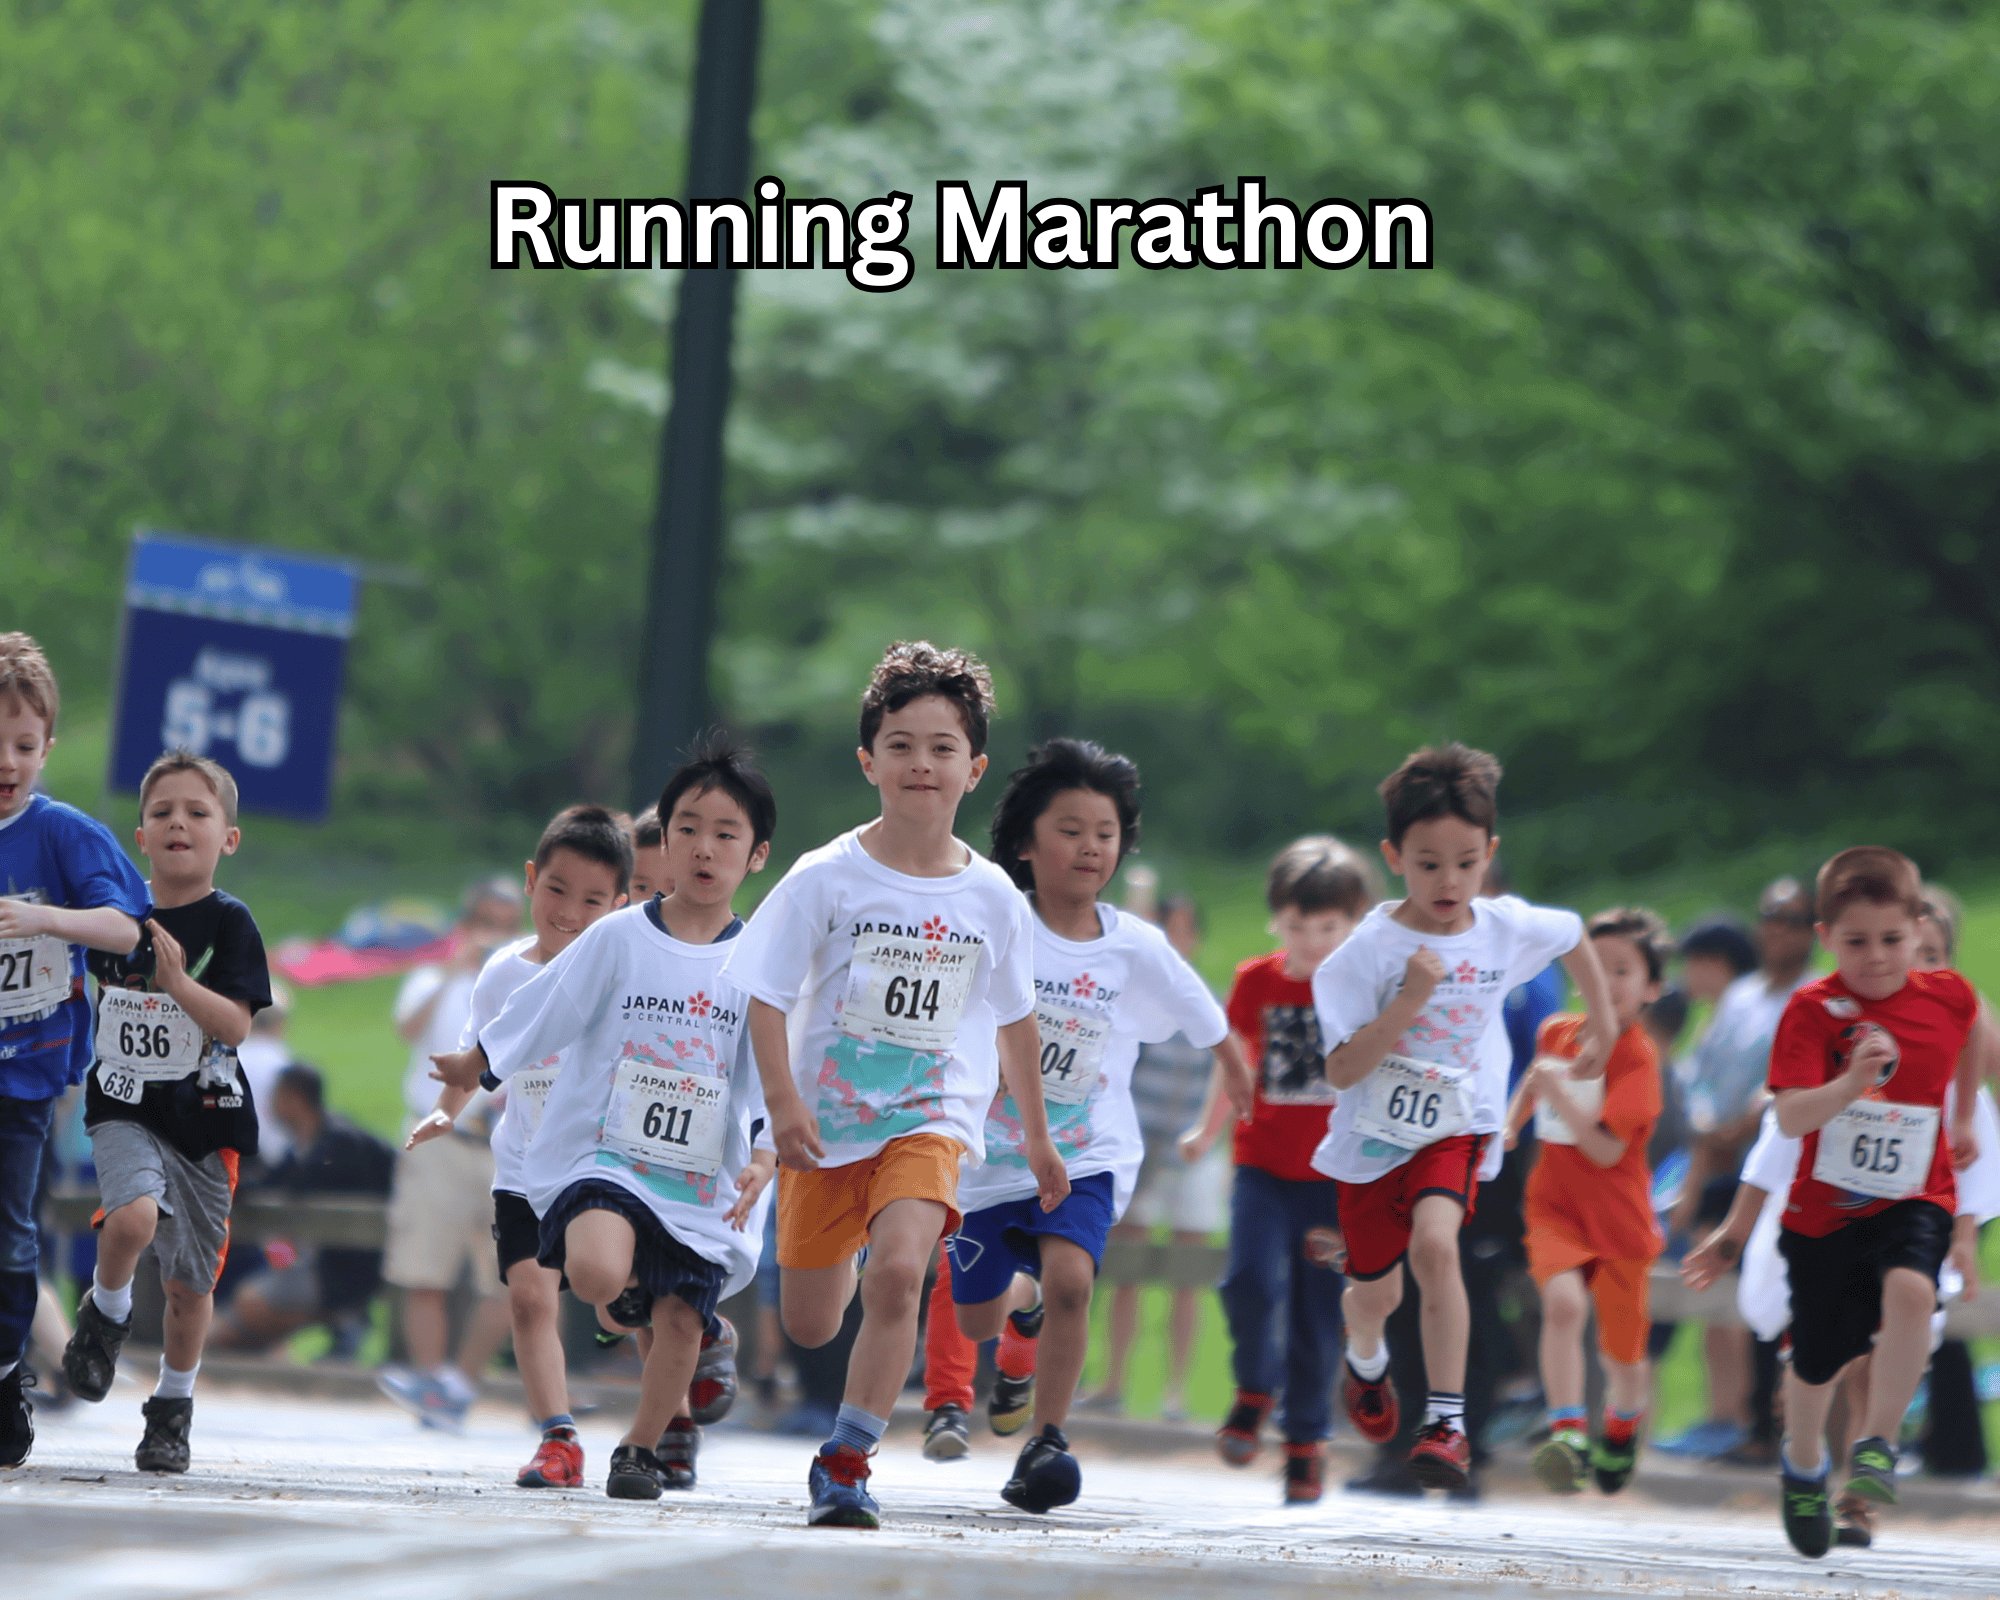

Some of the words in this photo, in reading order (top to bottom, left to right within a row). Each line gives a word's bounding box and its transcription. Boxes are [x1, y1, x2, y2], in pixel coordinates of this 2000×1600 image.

[162, 679, 291, 770] 5-6
[872, 946, 923, 963] JAPAN
[940, 954, 967, 965] DAY
[883, 961, 931, 973] CENTRAL
[107, 997, 142, 1012] JAPAN
[161, 1003, 185, 1013] DA
[622, 996, 685, 1014] JAPAN
[711, 1006, 739, 1026] DAY
[885, 975, 940, 1022] 614
[623, 1013, 630, 1021] @
[638, 1013, 700, 1029] CENTRAL
[1032, 1010, 1064, 1030] PAN
[1079, 1028, 1102, 1040] DAY
[120, 1022, 170, 1059] 636
[1039, 1037, 1078, 1081] 04
[103, 1071, 135, 1100] 636
[631, 1074, 678, 1092] JAPAN
[696, 1087, 720, 1100] DAY
[640, 1087, 687, 1102] CENTRAL
[694, 1098, 719, 1108] PARK
[1388, 1085, 1441, 1129] 616
[642, 1101, 693, 1147] 611
[1851, 1133, 1904, 1175] 615
